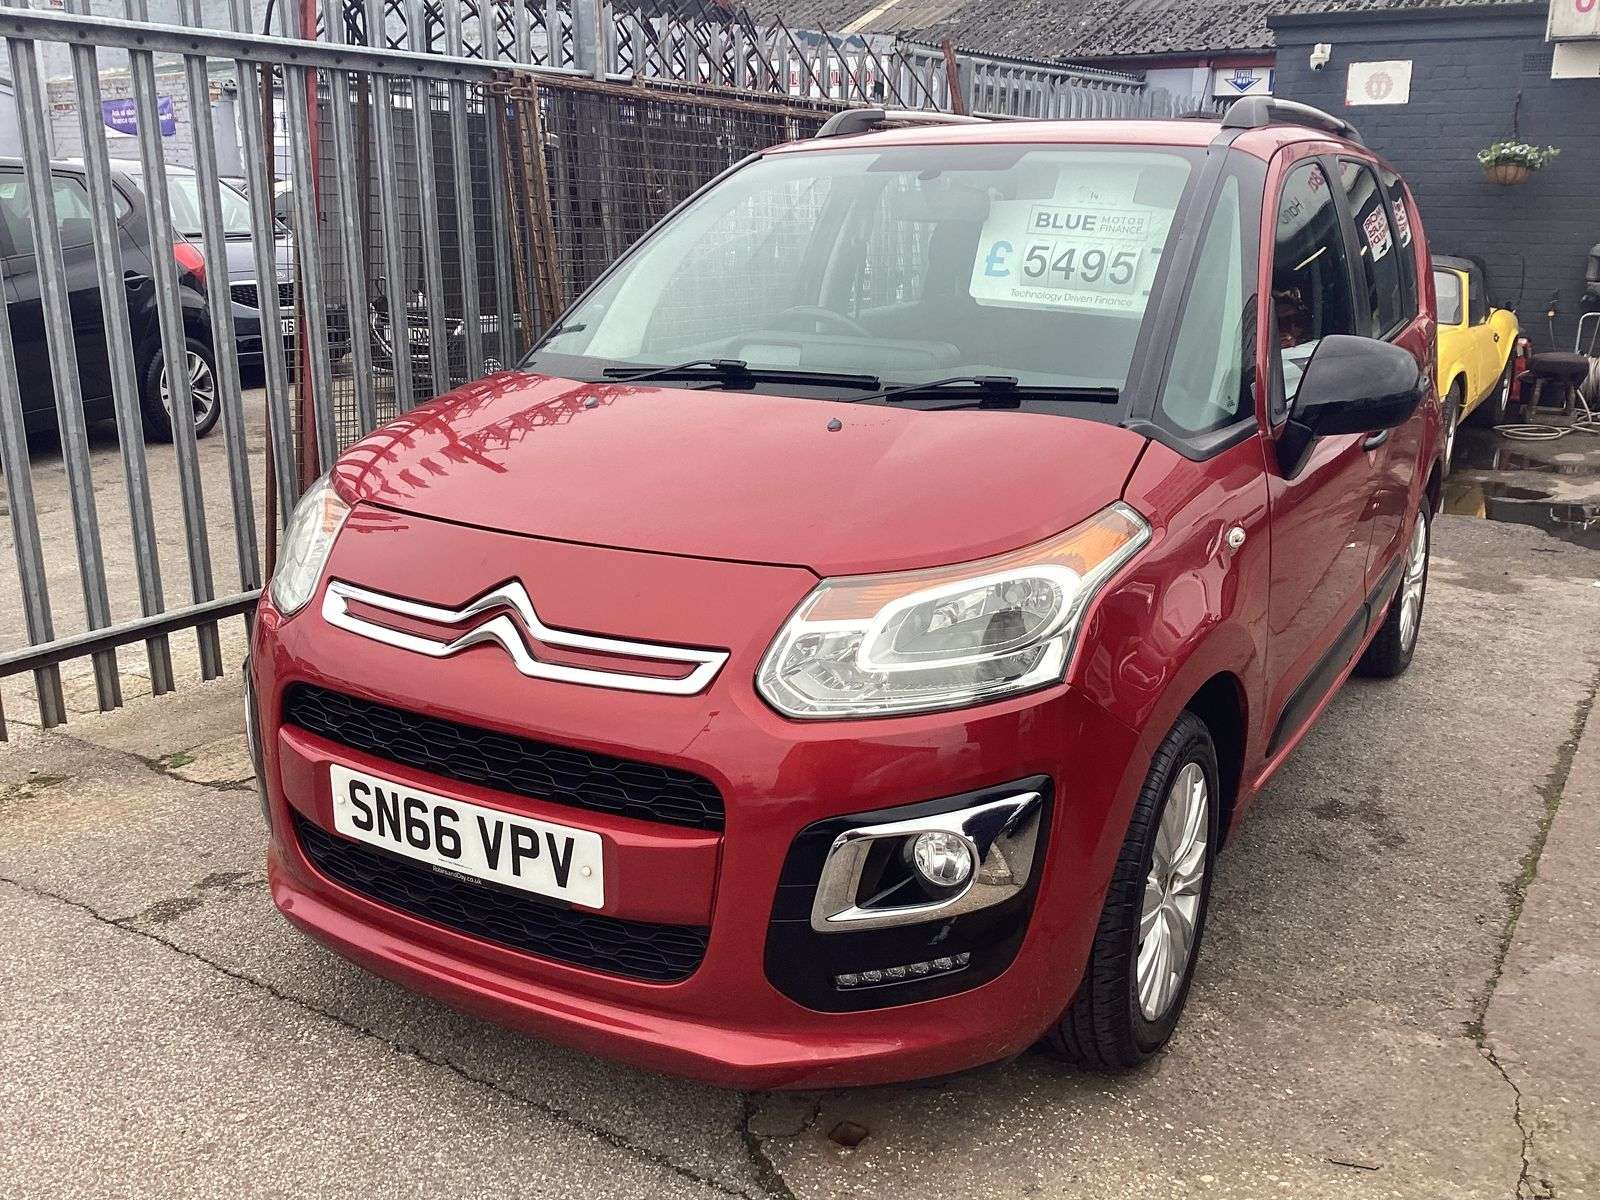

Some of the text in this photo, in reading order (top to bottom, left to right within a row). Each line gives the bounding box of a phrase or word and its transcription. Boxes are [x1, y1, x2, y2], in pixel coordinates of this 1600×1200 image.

[1035, 211, 1097, 231] BLUE
[1099, 224, 1142, 234] FINANCE
[1101, 215, 1144, 226] MOTOR
[1023, 245, 1136, 285] 5495
[1011, 288, 1133, 307] Technology Driven Finance
[349, 779, 575, 889] SN66 VPV
